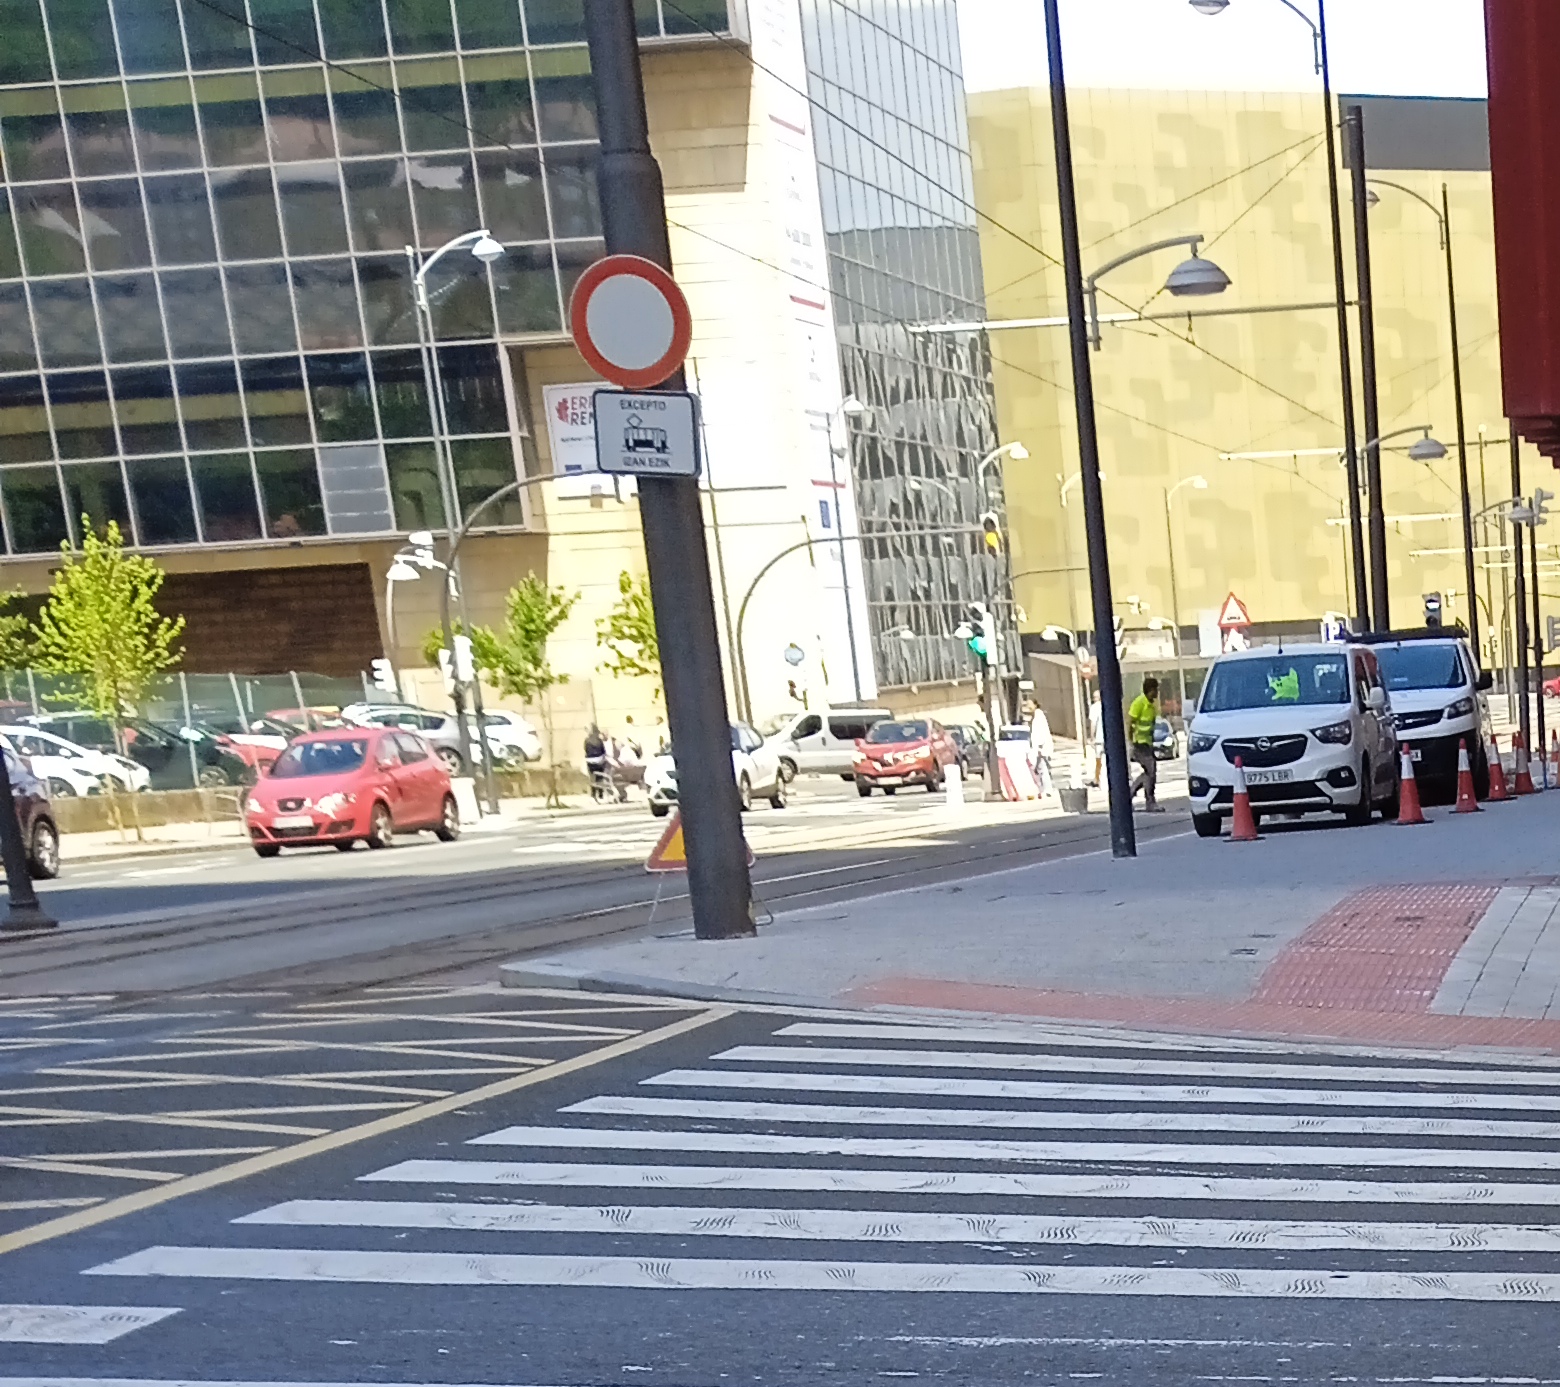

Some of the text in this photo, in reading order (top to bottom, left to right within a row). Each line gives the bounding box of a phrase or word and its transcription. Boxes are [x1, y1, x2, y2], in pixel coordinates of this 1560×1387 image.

[620, 399, 667, 411] EXCEPTO
[622, 456, 671, 468] IZAN EZIK
